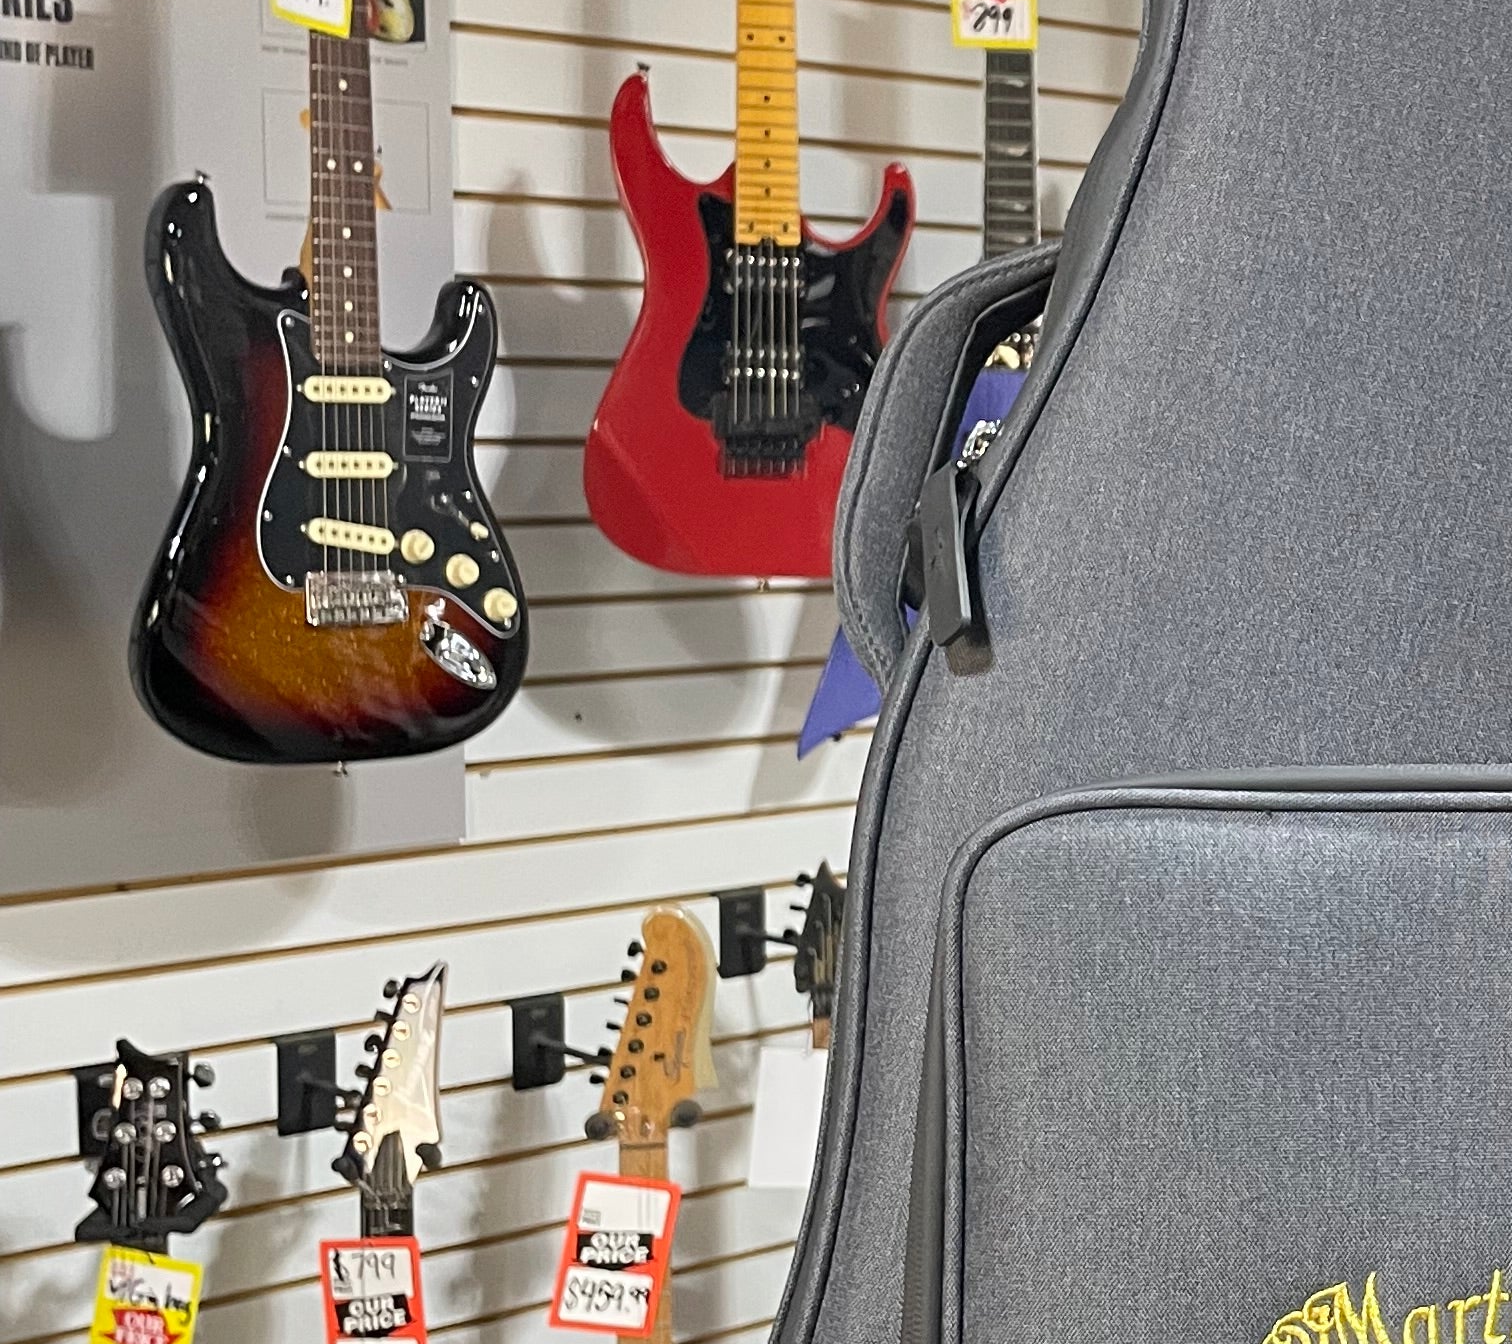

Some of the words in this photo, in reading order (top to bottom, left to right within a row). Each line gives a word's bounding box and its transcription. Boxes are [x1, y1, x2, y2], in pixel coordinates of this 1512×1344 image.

[591, 1232, 641, 1250] OUR
[580, 1245, 649, 1265] PRICE
[347, 1296, 394, 1317] OUR
[124, 1311, 165, 1330] OUR
[343, 1312, 406, 1334] PRICE
